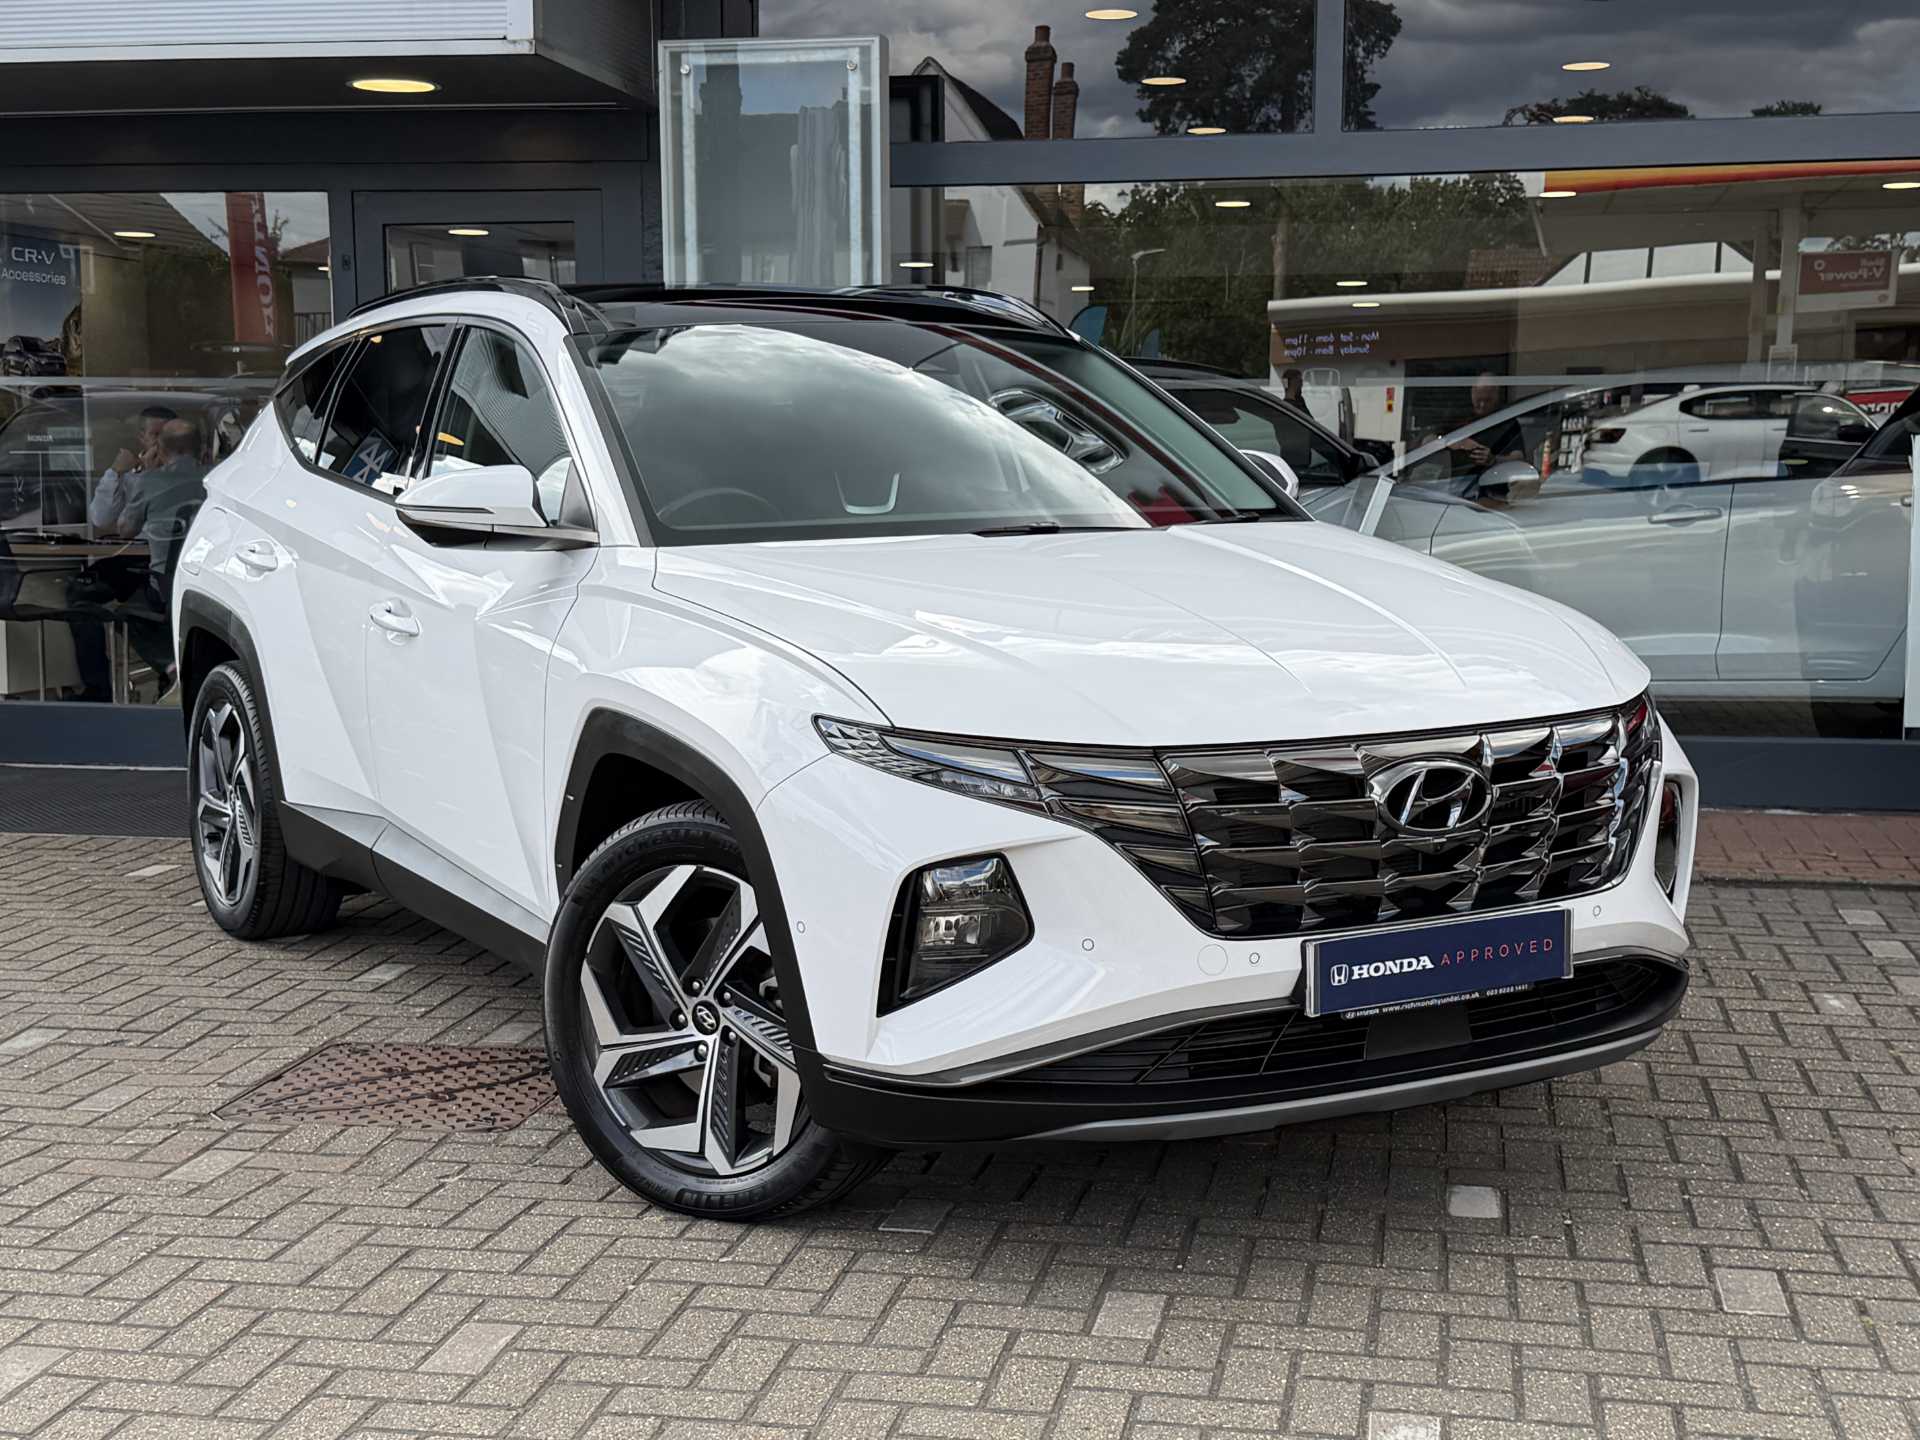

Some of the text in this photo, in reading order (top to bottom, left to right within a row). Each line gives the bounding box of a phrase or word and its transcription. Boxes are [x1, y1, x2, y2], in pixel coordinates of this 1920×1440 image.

[1, 267, 66, 286] Accessories
[1351, 938, 1553, 980] HONDA APPROVED
